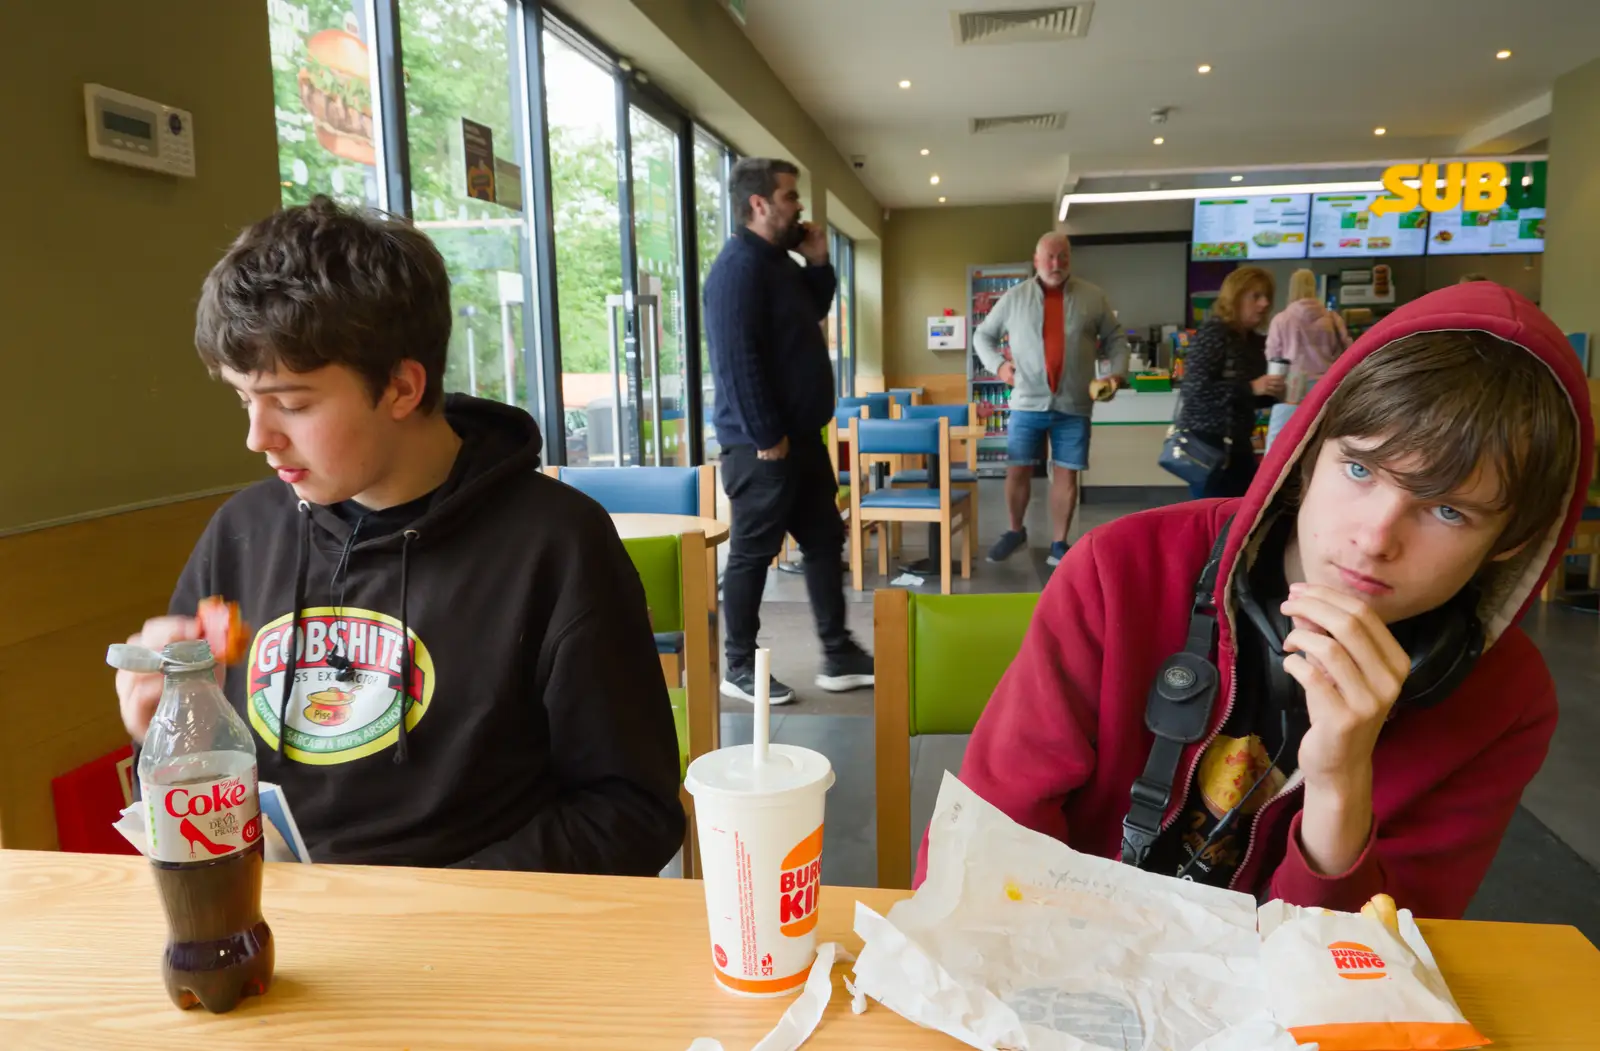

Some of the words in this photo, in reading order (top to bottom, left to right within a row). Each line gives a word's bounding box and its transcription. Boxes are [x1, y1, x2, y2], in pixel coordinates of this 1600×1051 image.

[165, 783, 246, 818] Coke
[1330, 949, 1380, 959] BURGER
[1333, 957, 1386, 969] KING
